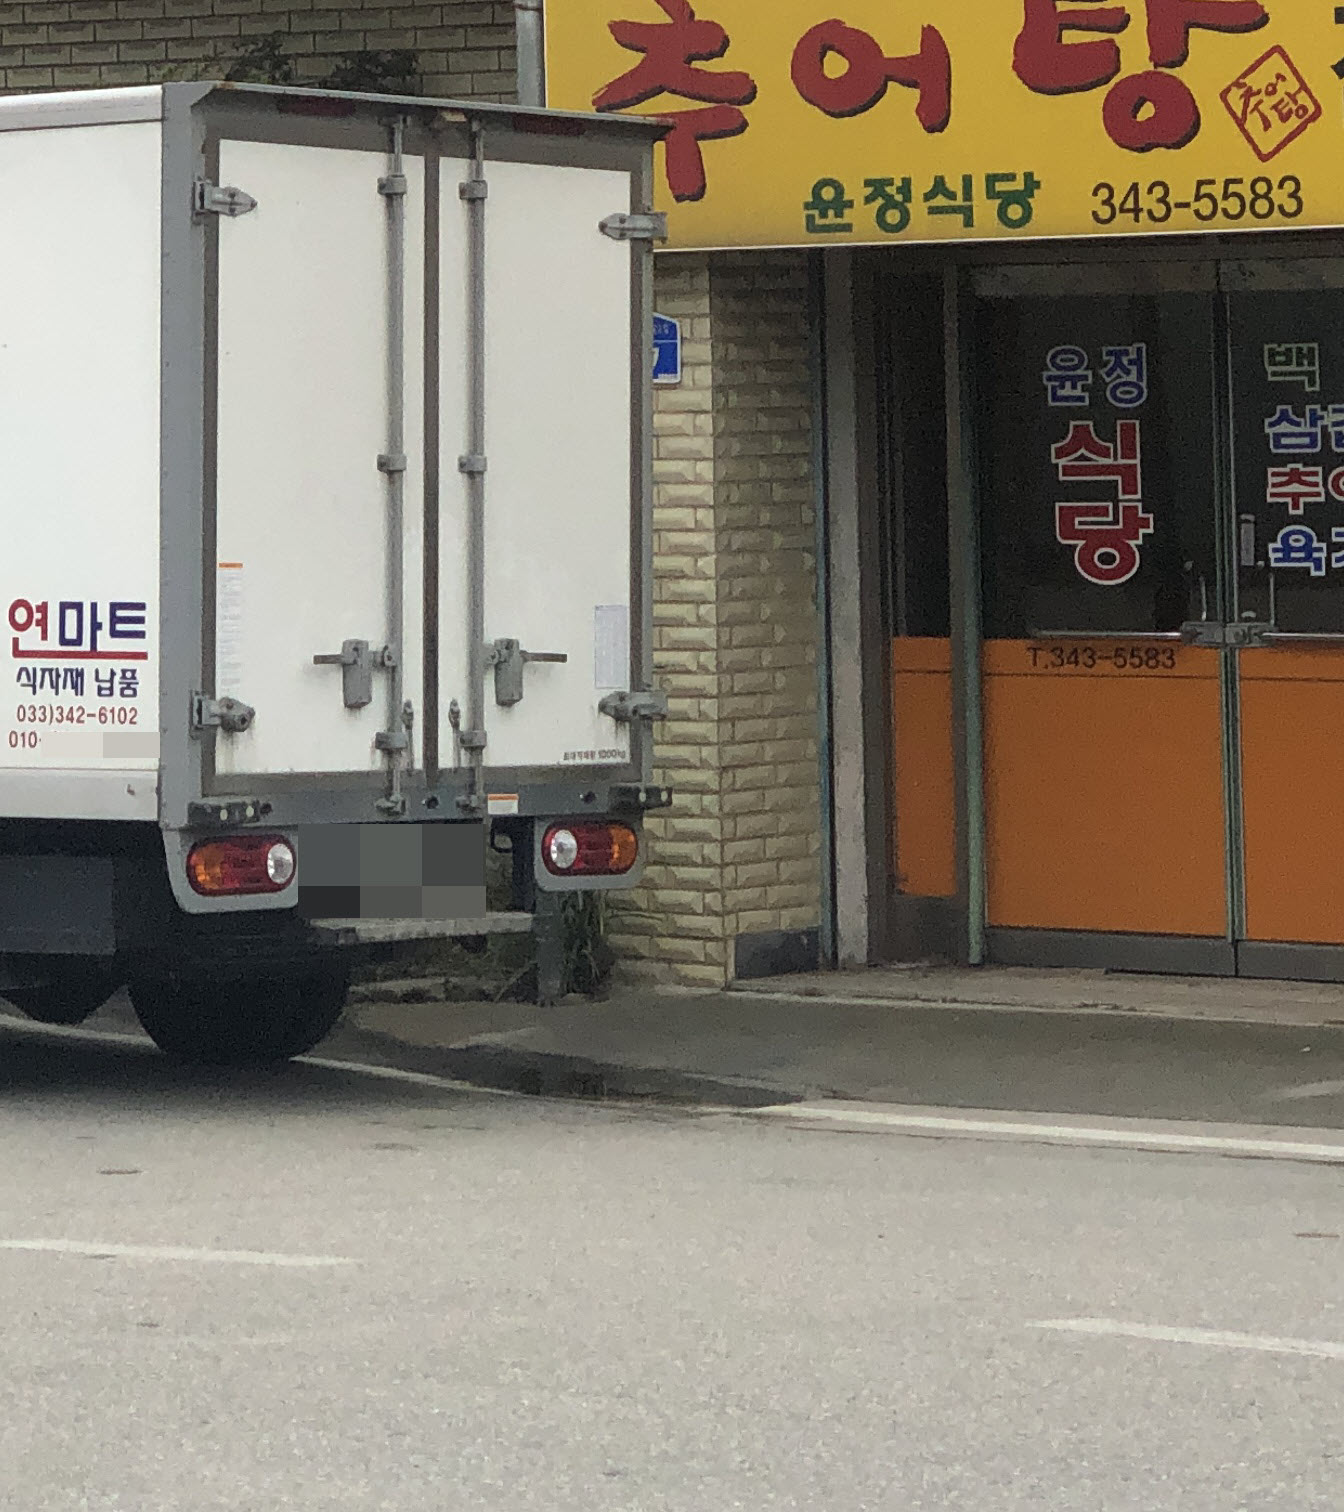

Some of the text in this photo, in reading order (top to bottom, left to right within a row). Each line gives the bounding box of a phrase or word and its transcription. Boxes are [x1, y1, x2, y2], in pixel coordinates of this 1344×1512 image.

[802, 169, 1042, 236] 윤정식당
[1090, 174, 1306, 227] 343-5583
[1043, 343, 1148, 409] 윤정
[1051, 419, 1155, 586] 식당
[16, 666, 140, 698] 식자재 납품
[16, 704, 138, 726] 033)342-6102
